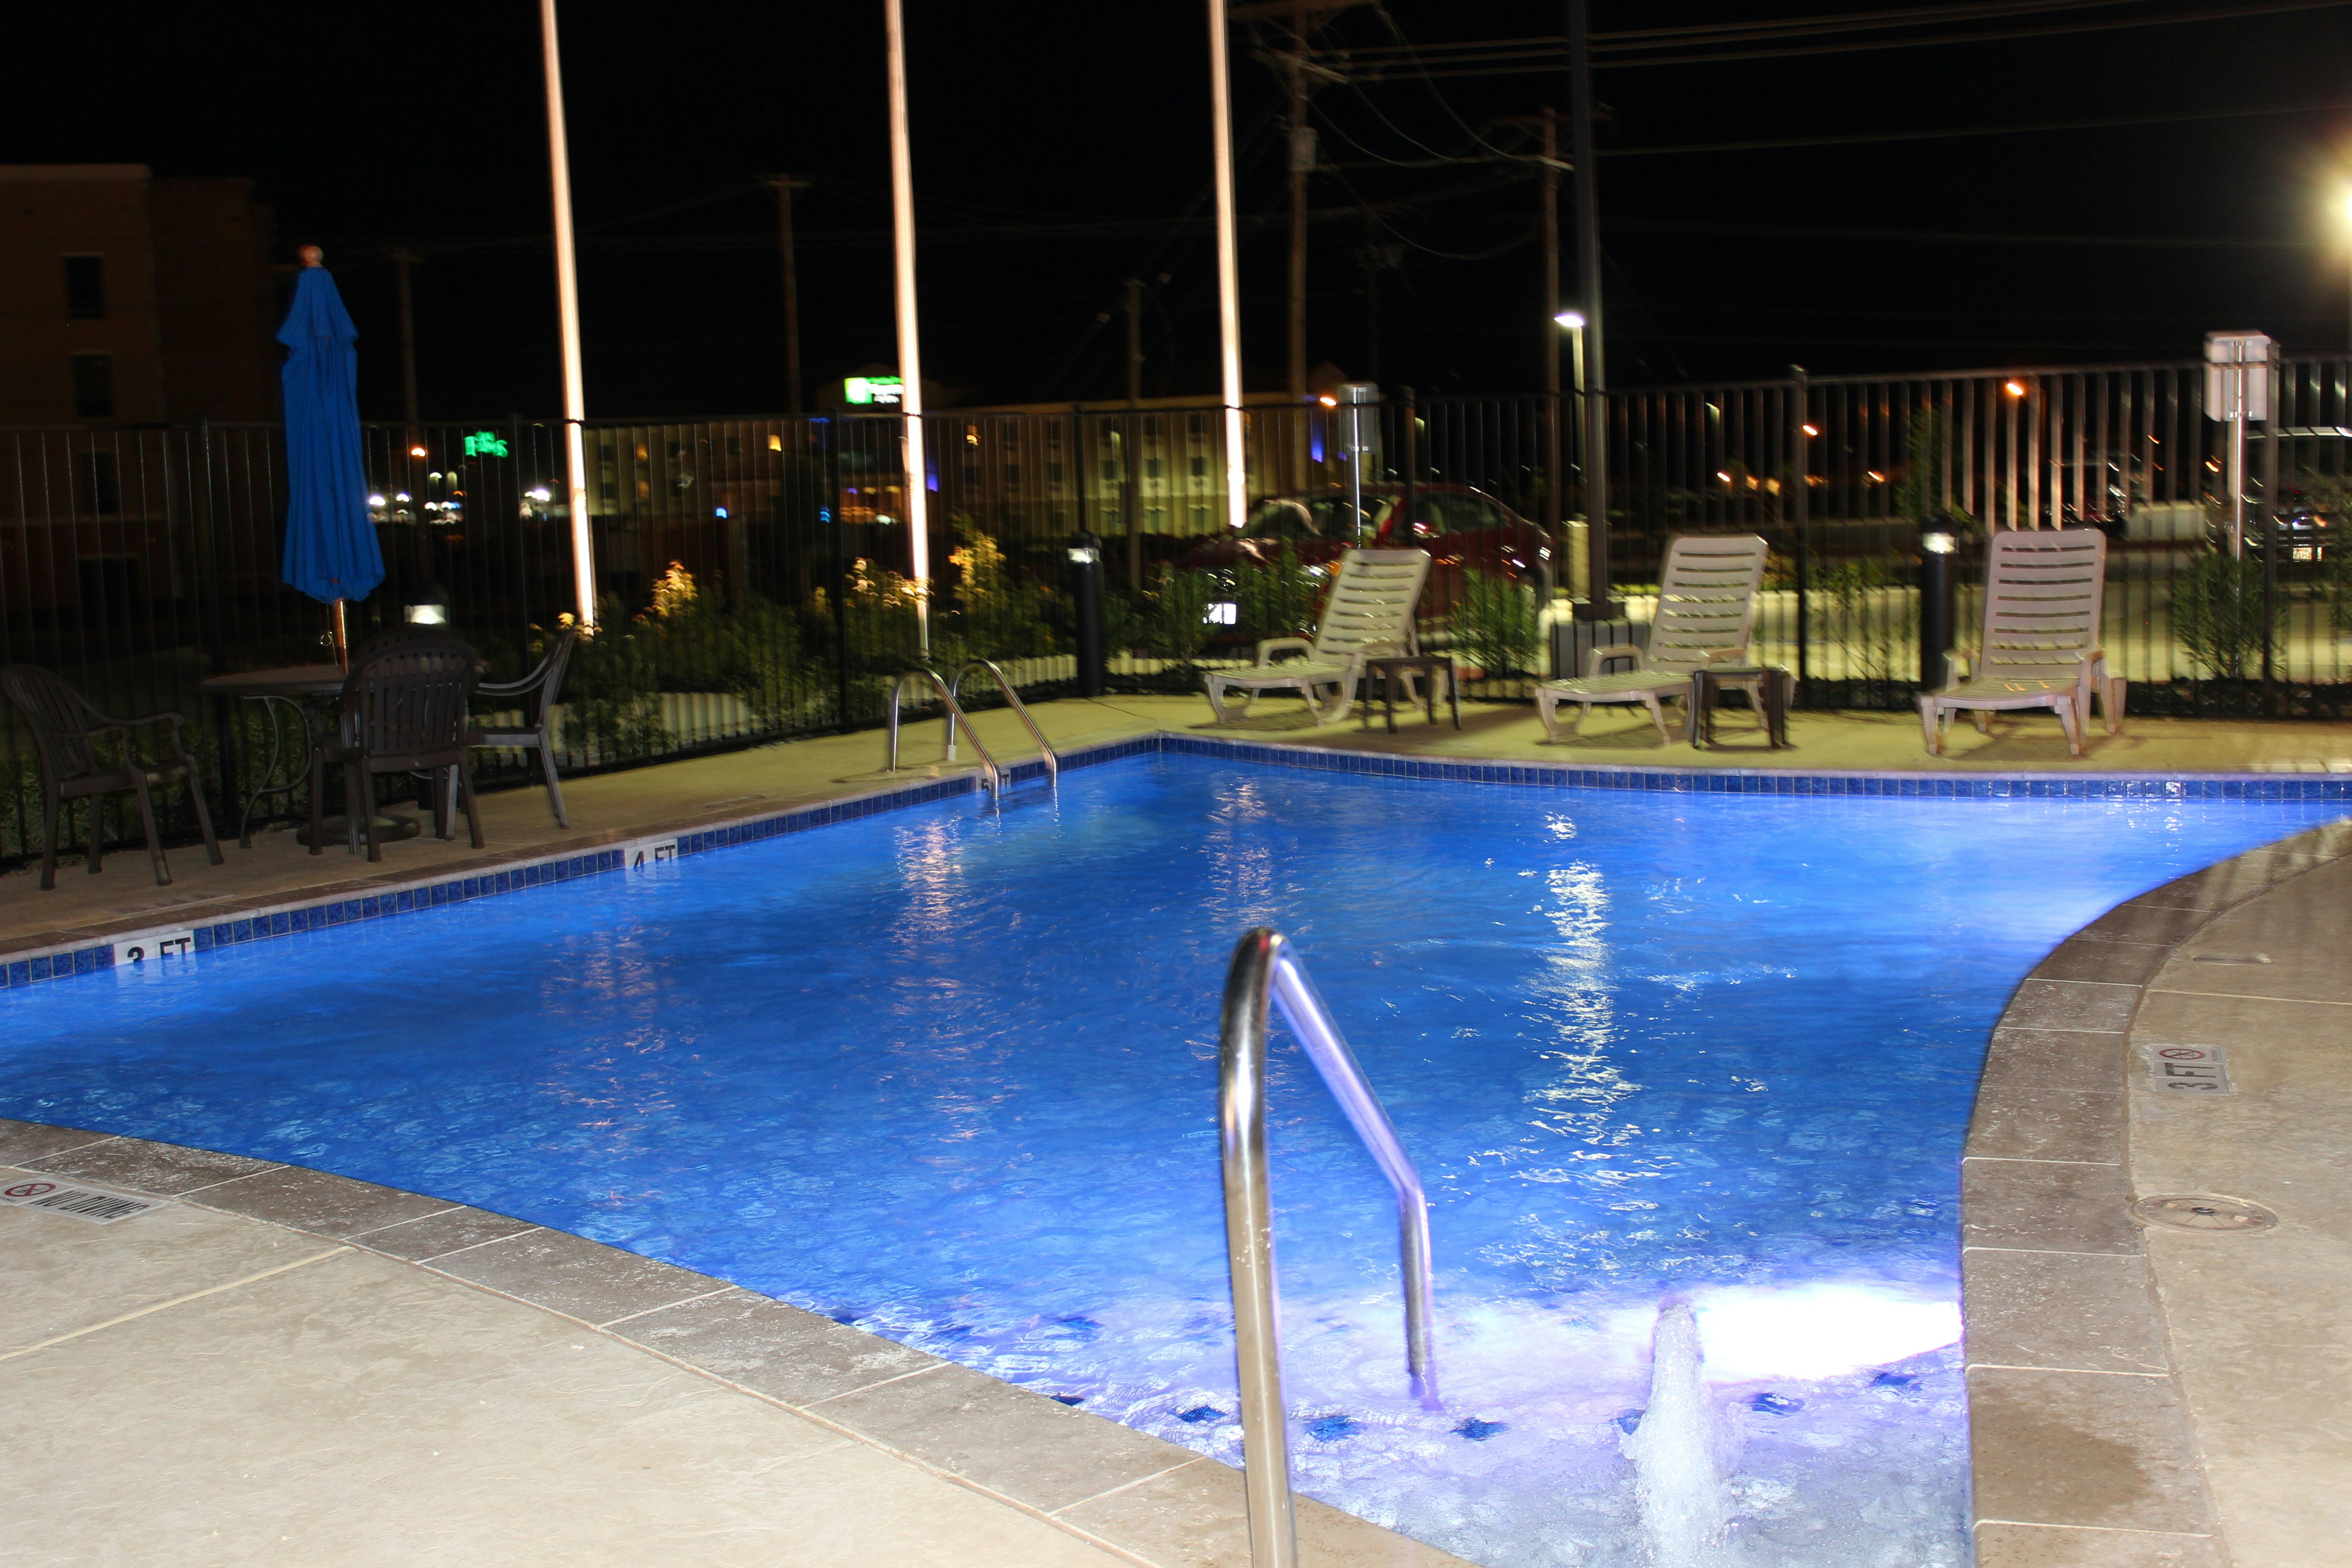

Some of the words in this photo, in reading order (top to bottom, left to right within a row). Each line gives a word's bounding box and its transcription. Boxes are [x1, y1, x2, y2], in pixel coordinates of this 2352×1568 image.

[2164, 1063, 2216, 1078] FT
[2167, 1082, 2218, 1090] 3
[58, 1196, 150, 1219] DIVING
